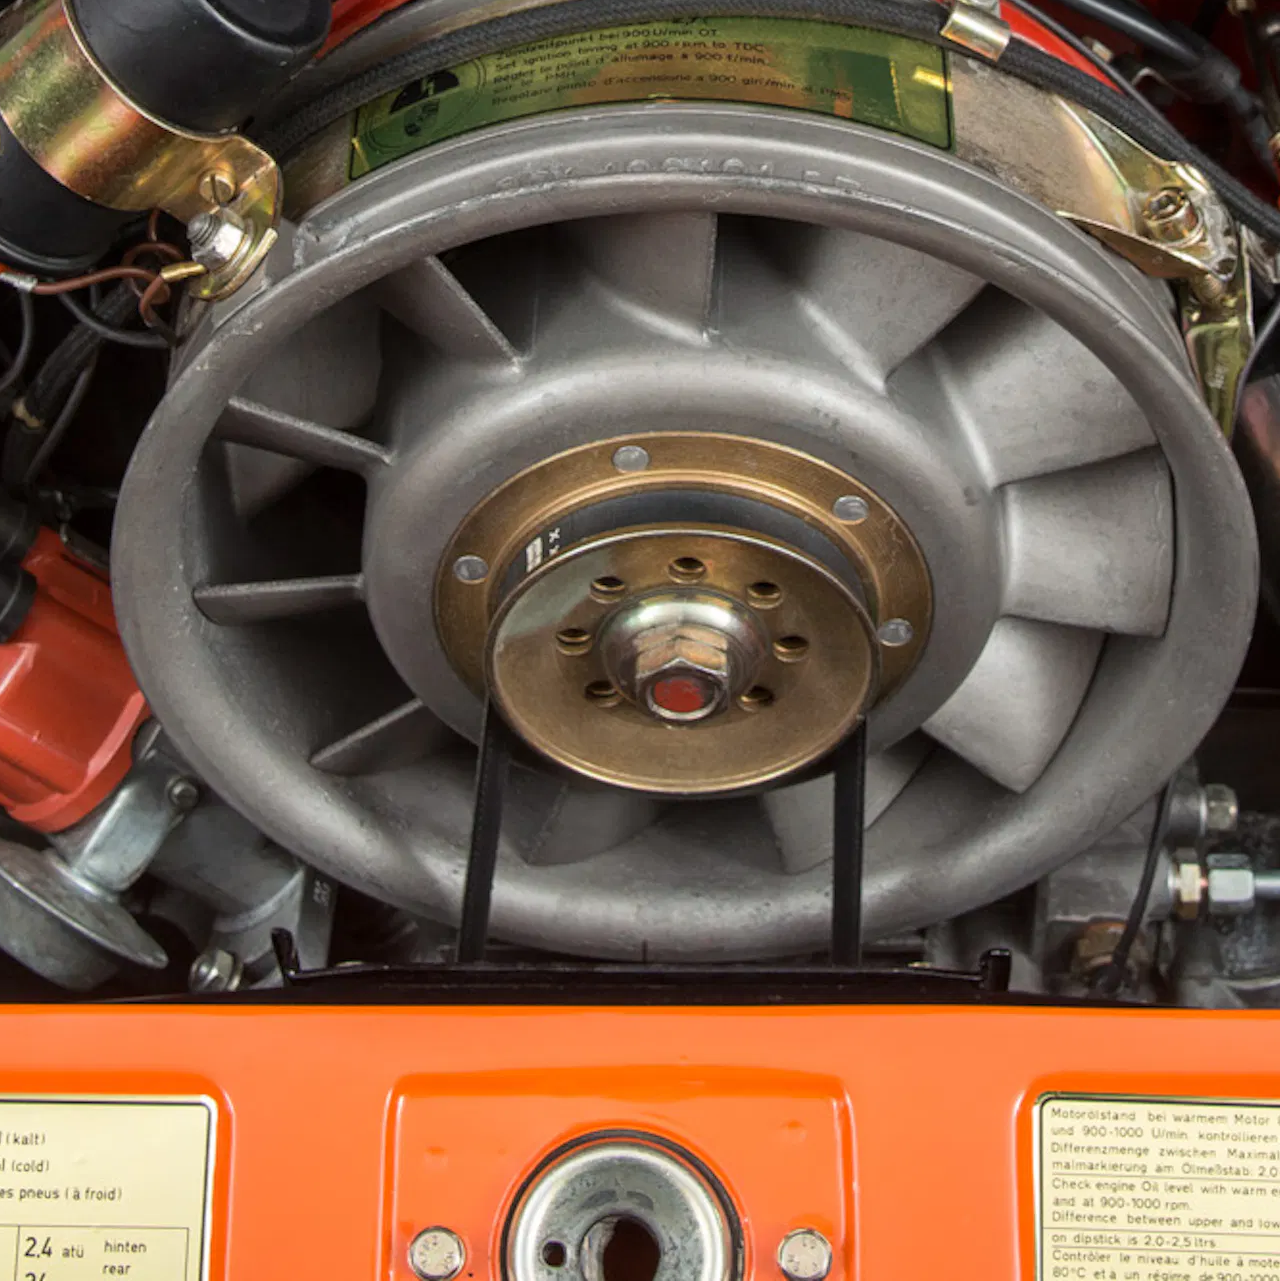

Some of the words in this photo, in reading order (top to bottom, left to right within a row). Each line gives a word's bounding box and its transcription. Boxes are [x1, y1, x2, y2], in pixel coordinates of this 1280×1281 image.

[733, 41, 764, 53] TDC
[1147, 1109, 1166, 1122] bei
[1172, 1113, 1228, 1124] warmem
[1234, 1113, 1270, 1126] Motor
[1050, 1126, 1074, 1137] und
[1151, 1127, 1188, 1140] U/min
[1198, 1129, 1278, 1143] kontrollieren
[1050, 1141, 1149, 1158] Differenzmenge
[1159, 1146, 1216, 1158] zwischen
[11, 1159, 50, 1173] (cold)
[1052, 1159, 1147, 1174] malmarkierung
[1155, 1163, 1174, 1174] am
[1052, 1177, 1091, 1191] Check
[1095, 1180, 1136, 1194] engine
[1141, 1180, 1159, 1193] Oil
[1164, 1181, 1193, 1194] level
[1200, 1183, 1227, 1196] with
[1231, 1185, 1267, 1197] warm
[19, 1188, 60, 1202] pneus
[1052, 1196, 1075, 1207] and
[1082, 1197, 1094, 1207] at
[1100, 1196, 1161, 1210] 900-1000
[1052, 1210, 1117, 1224] Difference
[1127, 1213, 1181, 1226] between
[1188, 1217, 1223, 1228] upper
[1230, 1217, 1254, 1229] and
[103, 1239, 148, 1254] hinten
[1052, 1233, 1067, 1242] on
[1073, 1233, 1120, 1246] dipstick
[1127, 1235, 1138, 1246] is
[61, 1243, 85, 1259] atü
[1120, 1252, 1131, 1263] le
[1137, 1253, 1179, 1266] niveau
[1187, 1254, 1230, 1267] d'huile
[101, 1263, 131, 1276] rear
[1052, 1265, 1086, 1279] 80°C
[1124, 1270, 1140, 1280] un
[1199, 1270, 1214, 1281] de
